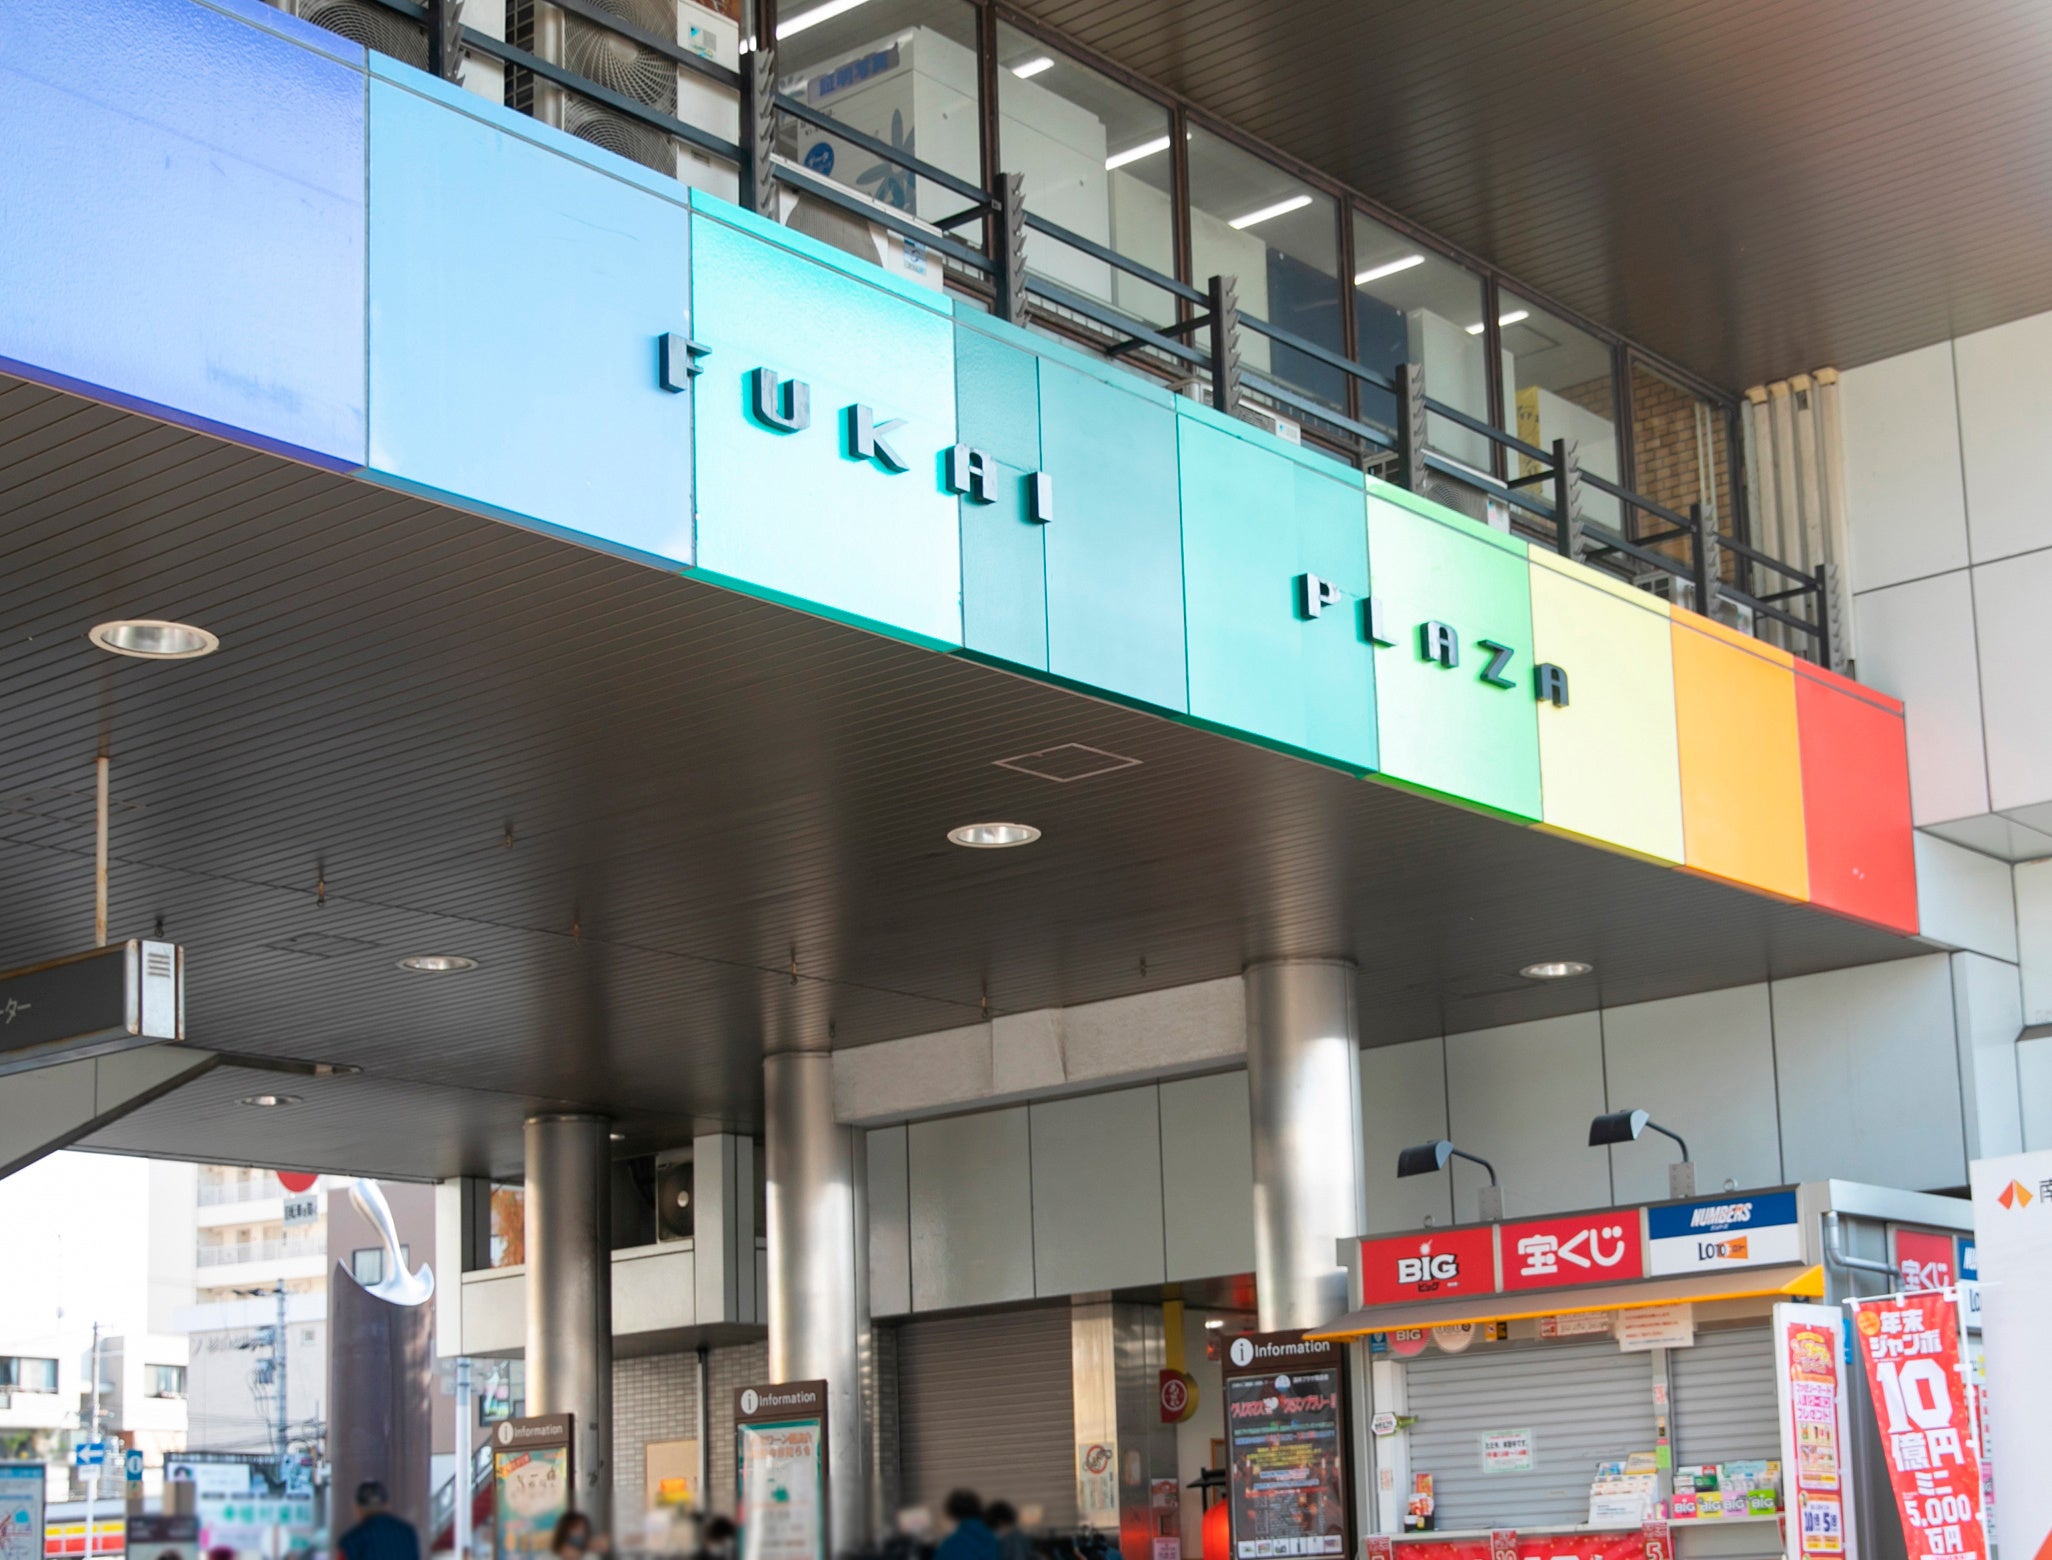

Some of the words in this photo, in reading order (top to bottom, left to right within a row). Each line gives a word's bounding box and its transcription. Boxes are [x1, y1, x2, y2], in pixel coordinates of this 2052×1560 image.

[658, 332, 1053, 524] FUKAI
[1297, 573, 1570, 708] PLAZA
[1690, 1202, 1753, 1228] NUMBERS
[1518, 1226, 1626, 1276] 宝くじ
[1901, 1259, 1950, 1293] 宝くじ
[1881, 1309, 1925, 1335] 年末
[1254, 1340, 1330, 1358] Information
[1869, 1329, 1943, 1359] ジャンボ
[760, 1391, 817, 1407] Information
[1876, 1358, 1954, 1435] 10
[514, 1423, 563, 1438] Information
[1890, 1428, 1965, 1472] 億円
[1915, 1470, 1953, 1496] ミニ
[1924, 1524, 1964, 1555] 万円
